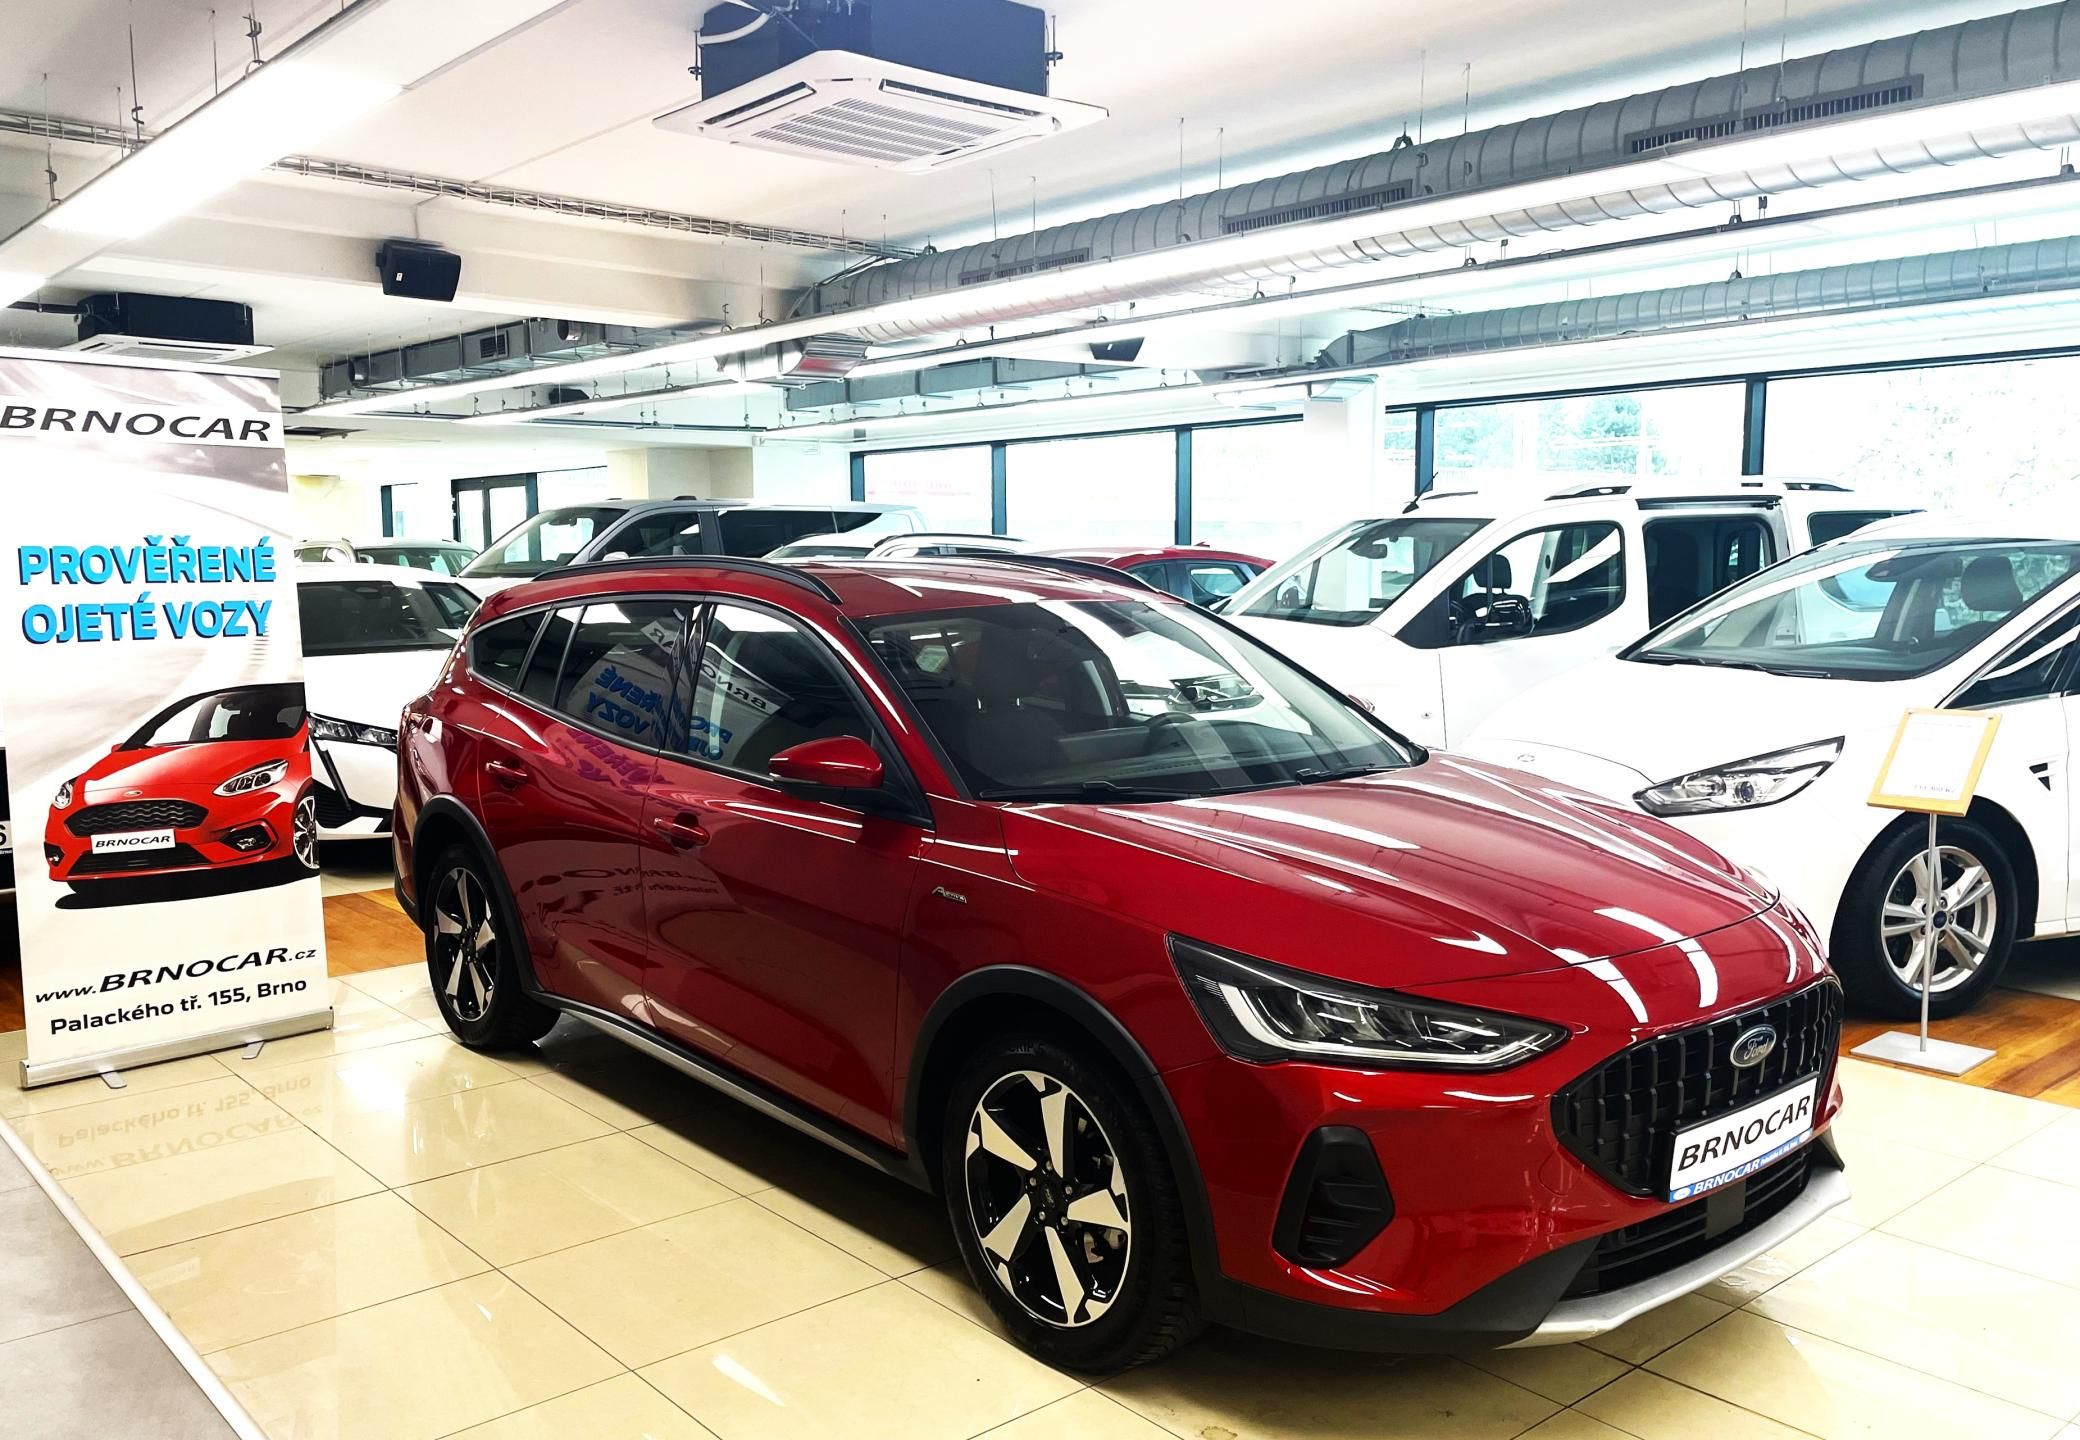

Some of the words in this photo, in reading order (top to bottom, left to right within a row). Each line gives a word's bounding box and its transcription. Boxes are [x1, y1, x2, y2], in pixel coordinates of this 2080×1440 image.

[0, 405, 271, 442] BRNOCAR
[18, 534, 277, 585] PROVĚŘENÉ
[22, 591, 157, 644] OJETÉ
[162, 600, 272, 639] VOZY
[95, 835, 171, 848] BRNOCAR
[35, 947, 317, 1003] www.BRNOCAR.cz
[50, 1003, 174, 1035] Palackého
[180, 994, 202, 1011] tř.
[208, 987, 251, 1006] 155,
[257, 980, 307, 998] Brno
[1678, 1094, 1811, 1172] BRNOCAR
[1692, 1158, 1760, 1196] BRNOCAR
